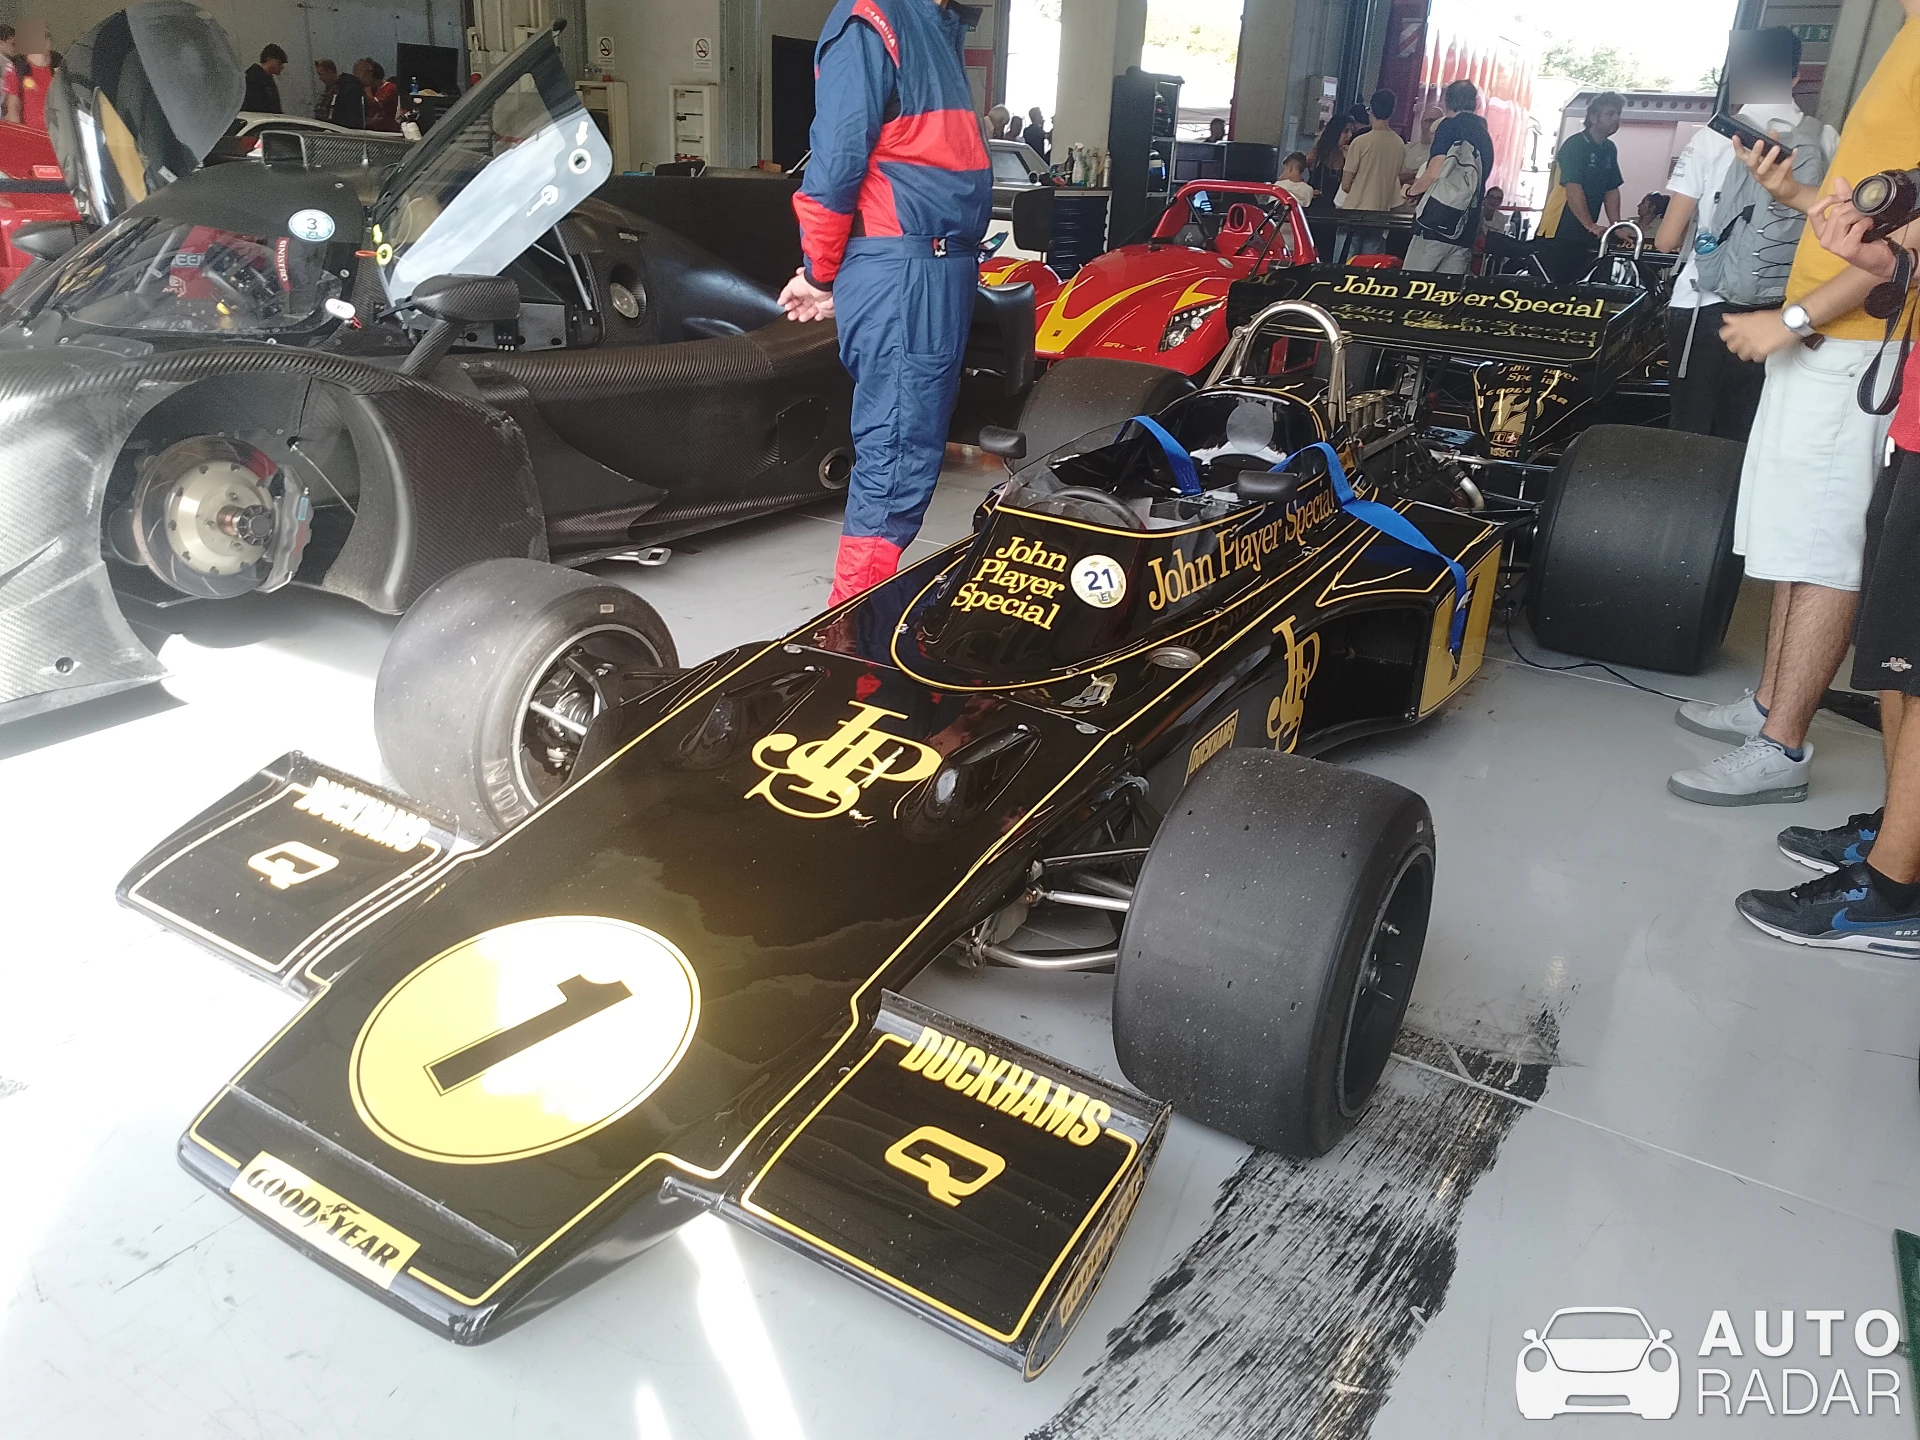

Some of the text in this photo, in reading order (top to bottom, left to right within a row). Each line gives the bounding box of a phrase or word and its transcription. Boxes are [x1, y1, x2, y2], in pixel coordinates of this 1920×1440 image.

[306, 218, 317, 230] 3
[1333, 274, 1605, 319] John Player Special
[995, 536, 1067, 573] John
[1147, 486, 1337, 611] John Player Special
[971, 558, 1066, 599] Player
[1083, 568, 1115, 592] 21
[1101, 593, 1109, 602] E
[951, 582, 1061, 631] Special
[424, 973, 633, 1096] 1
[898, 1026, 1112, 1148] DUCKHAMS
[884, 1124, 1007, 1208] Q
[247, 1168, 401, 1269] GOODYEAR
